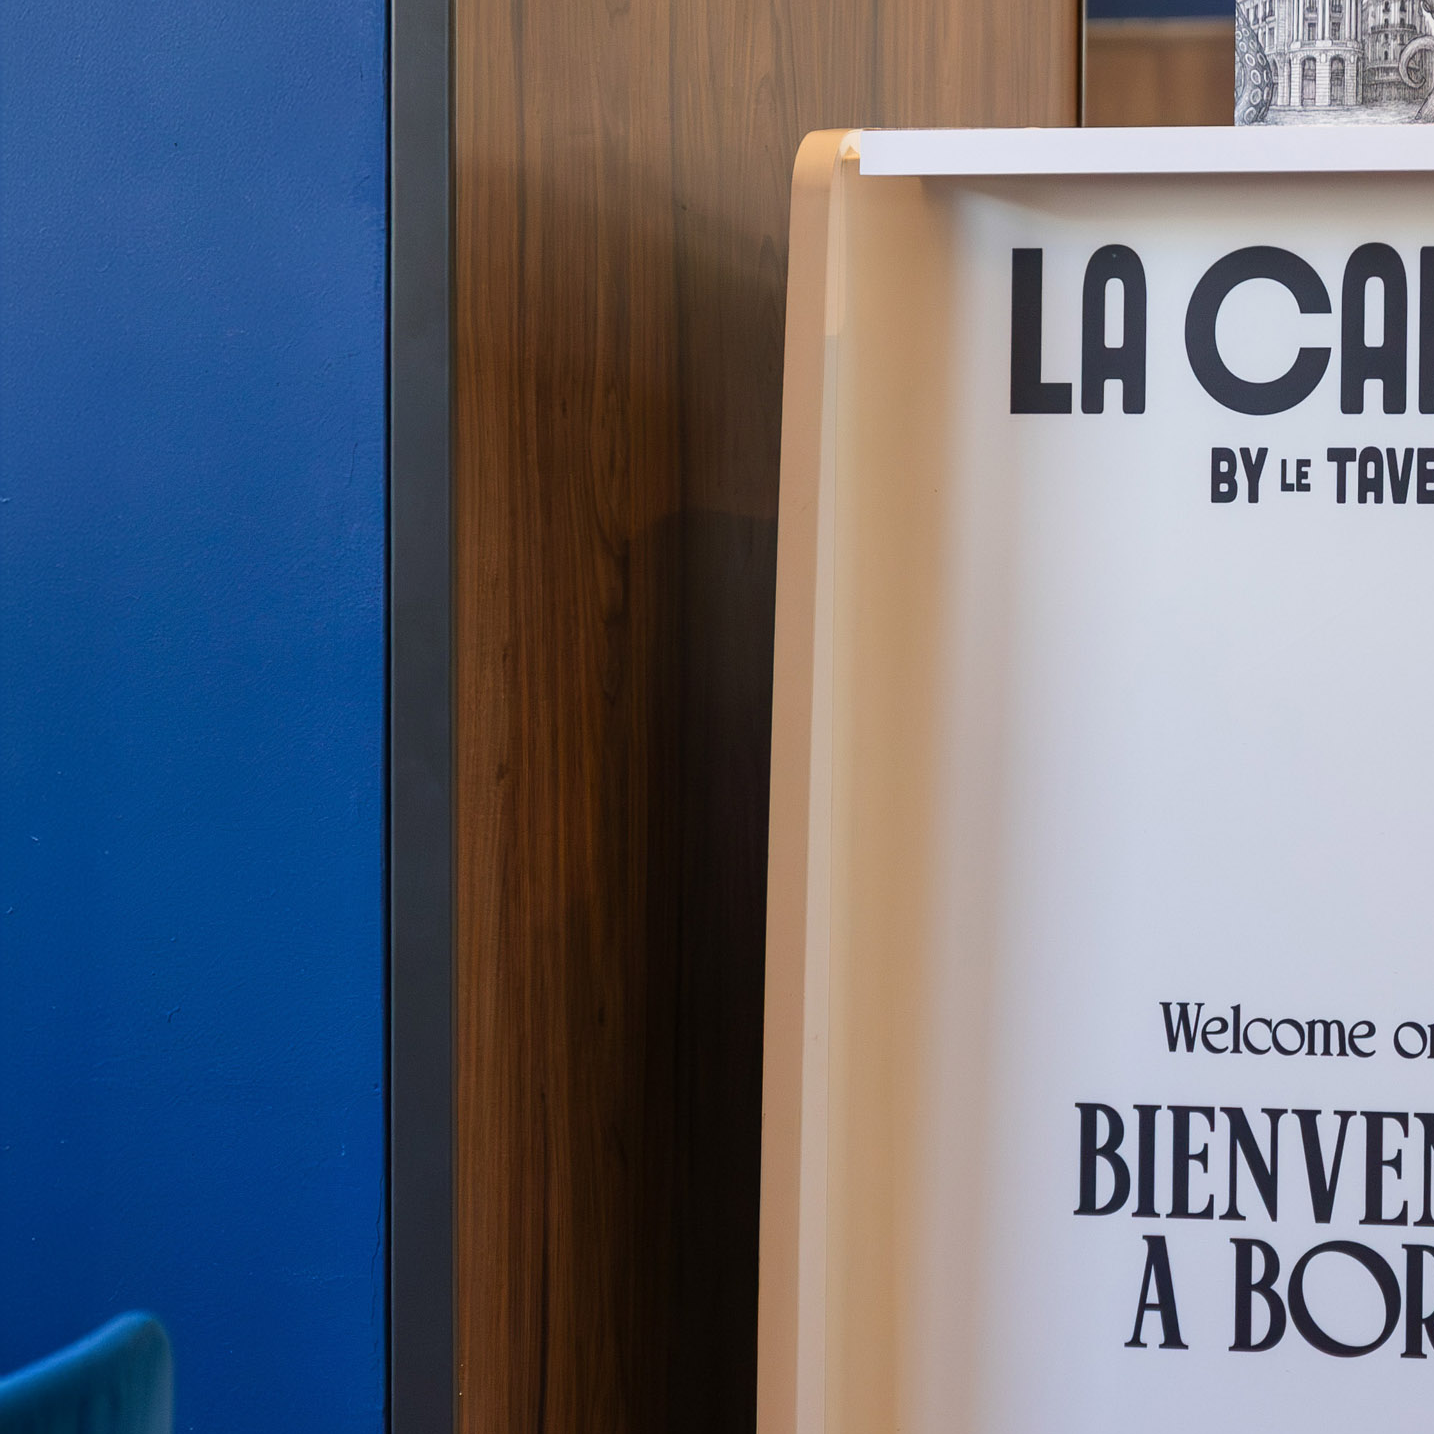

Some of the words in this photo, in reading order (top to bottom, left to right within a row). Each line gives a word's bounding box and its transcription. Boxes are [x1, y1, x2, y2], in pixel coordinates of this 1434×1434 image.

[1009, 243, 1147, 415] LA
[1210, 447, 1269, 504] BY
[1280, 458, 1312, 492] LE
[1159, 1001, 1377, 1059] Welcome
[1124, 1234, 1189, 1350] A
